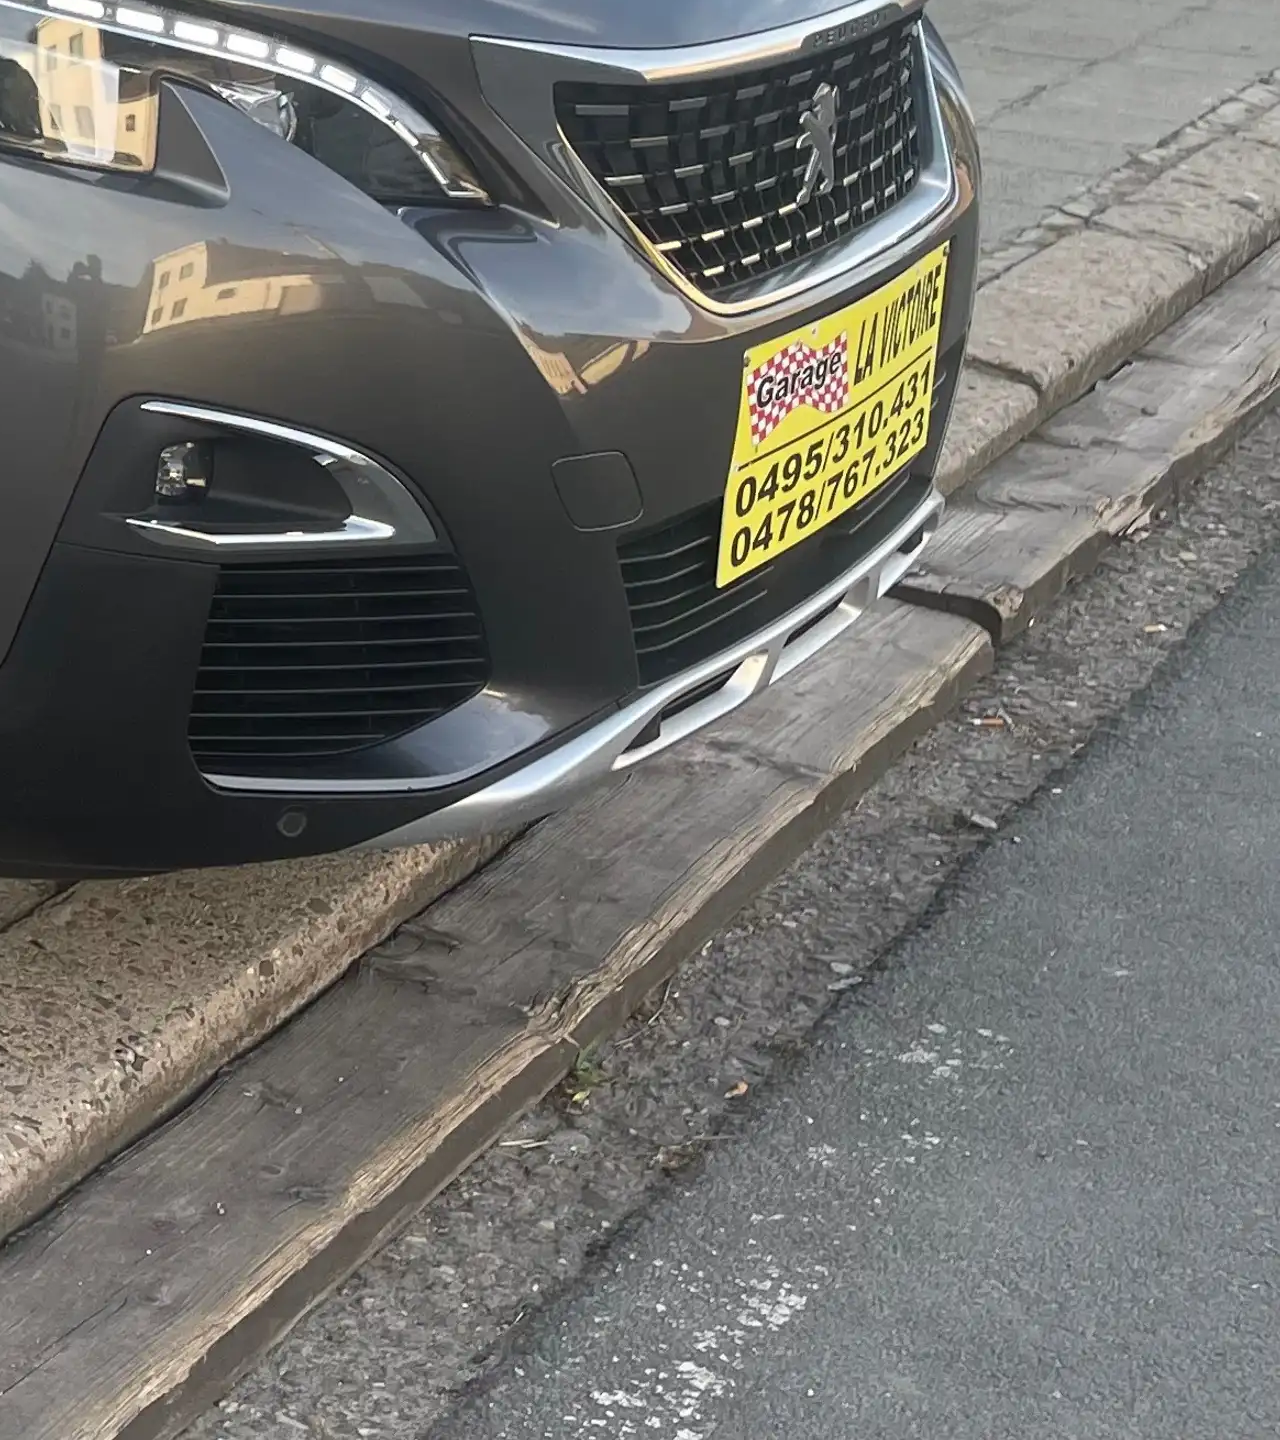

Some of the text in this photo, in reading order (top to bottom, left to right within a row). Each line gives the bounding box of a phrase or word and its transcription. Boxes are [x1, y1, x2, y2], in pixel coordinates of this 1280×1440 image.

[756, 263, 943, 409] Garage LA VICTOIRE
[730, 407, 925, 568] 0478/767.323
[735, 360, 931, 517] 0495/310.431
